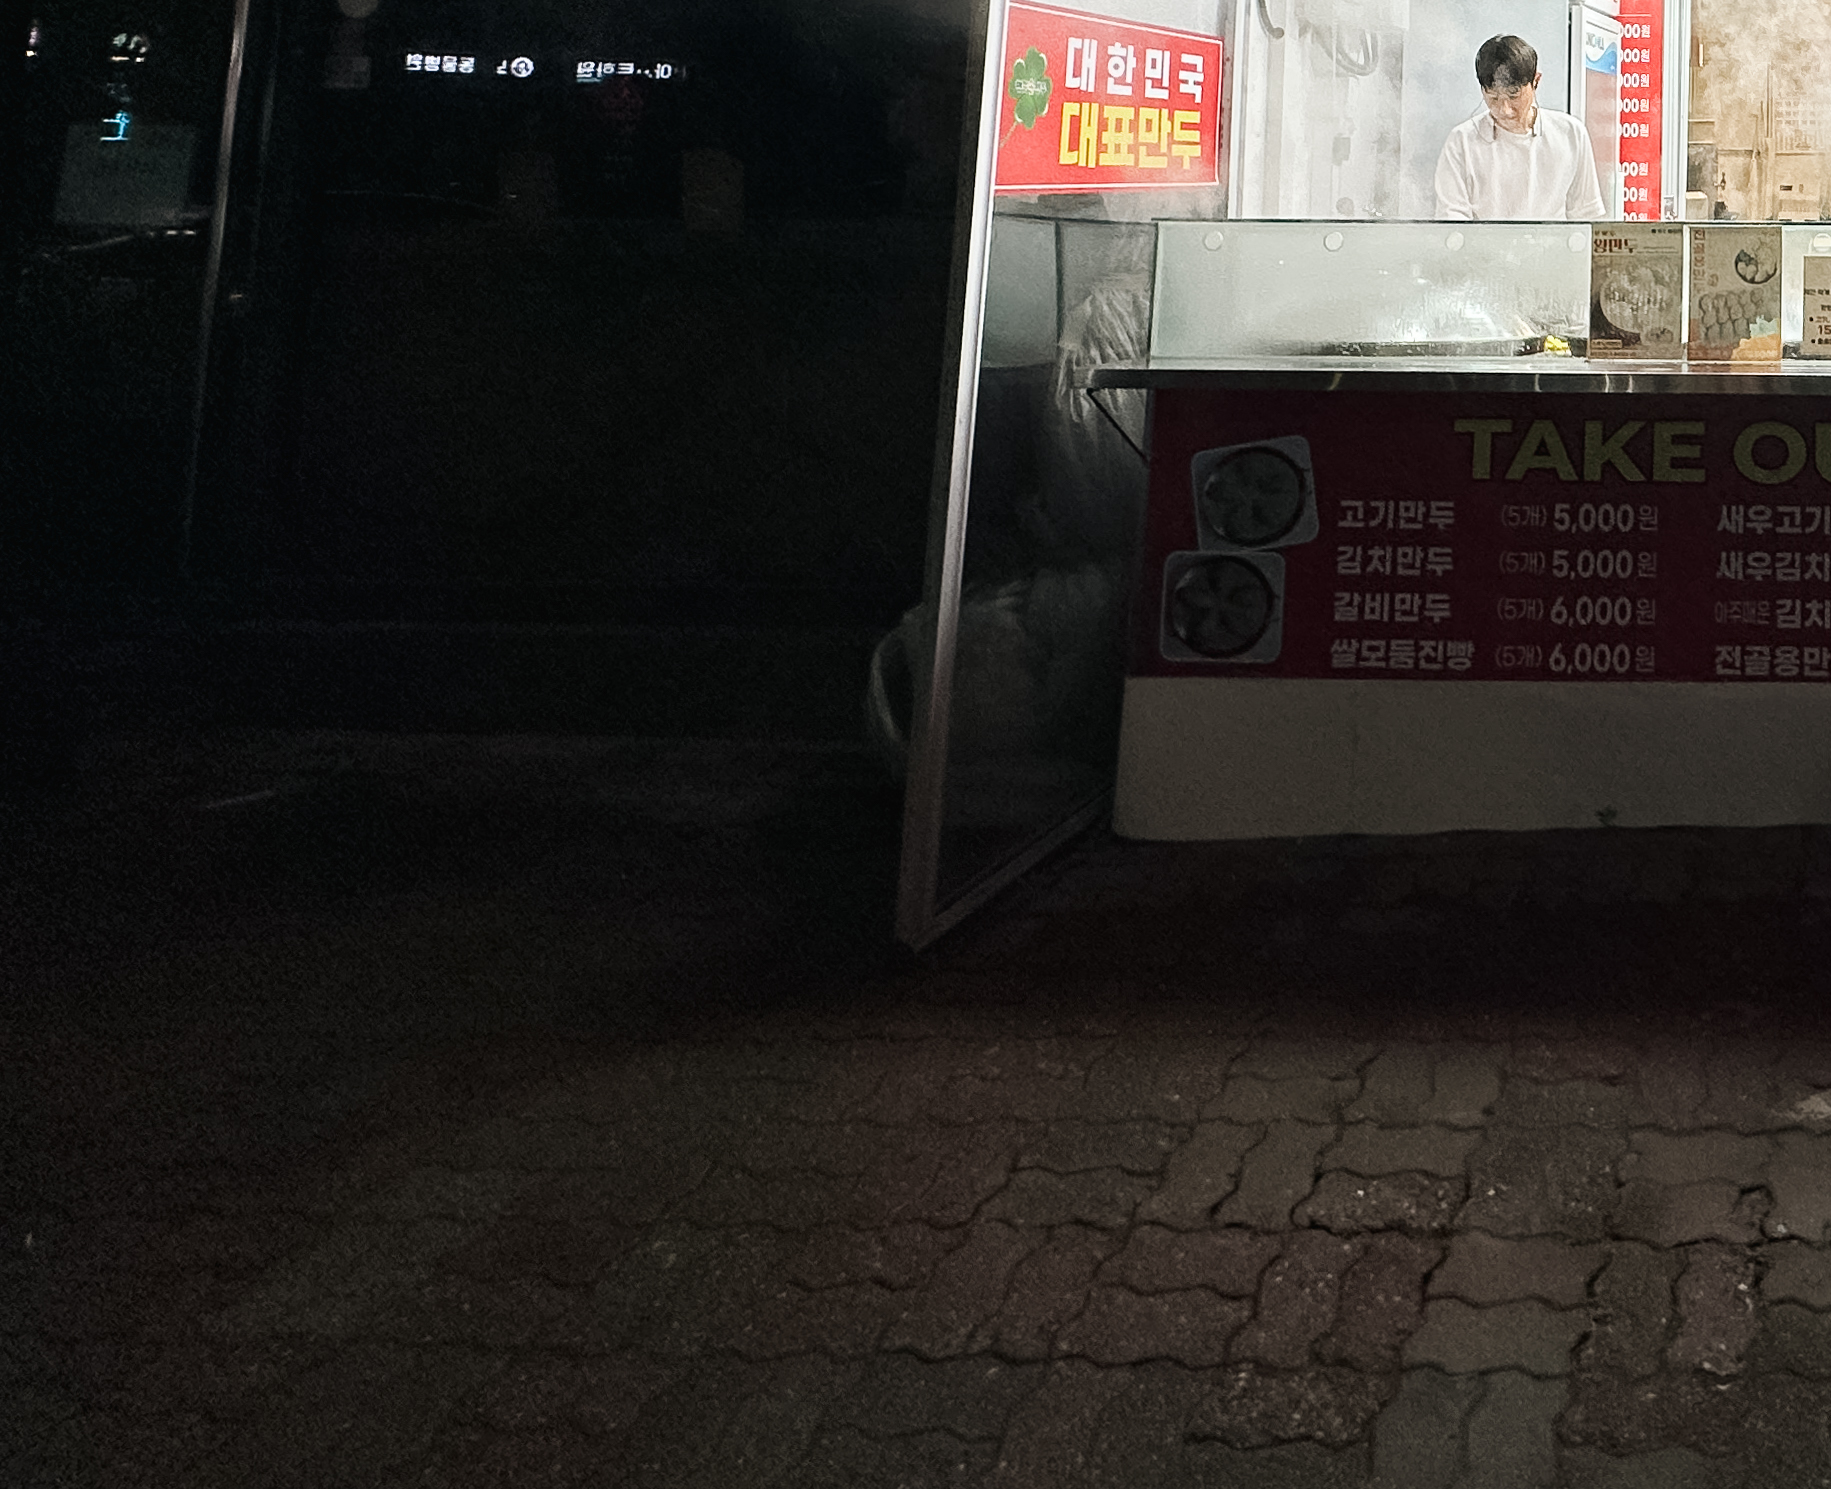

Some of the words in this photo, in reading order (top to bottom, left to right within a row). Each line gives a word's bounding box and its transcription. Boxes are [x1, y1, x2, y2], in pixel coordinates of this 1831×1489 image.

[1065, 37, 1204, 104] 대한민국
[1059, 102, 1201, 170] 대표만두
[1454, 419, 1707, 482] TAKE
[1337, 500, 1456, 530] 고기만두
[1500, 504, 1548, 529] (5개)
[1553, 502, 1659, 534] 5,000원
[1336, 545, 1454, 576] 김치만두
[1499, 551, 1546, 575] (5개)
[1551, 550, 1658, 581] 5,000원
[1334, 591, 1452, 623] 갈비만두
[1497, 597, 1545, 621] (5개)
[1550, 596, 1657, 627] 6,000원
[1330, 638, 1476, 671] 쌀모둠진빵
[1495, 643, 1543, 668] (5개)
[1548, 642, 1656, 675] 6,000원
